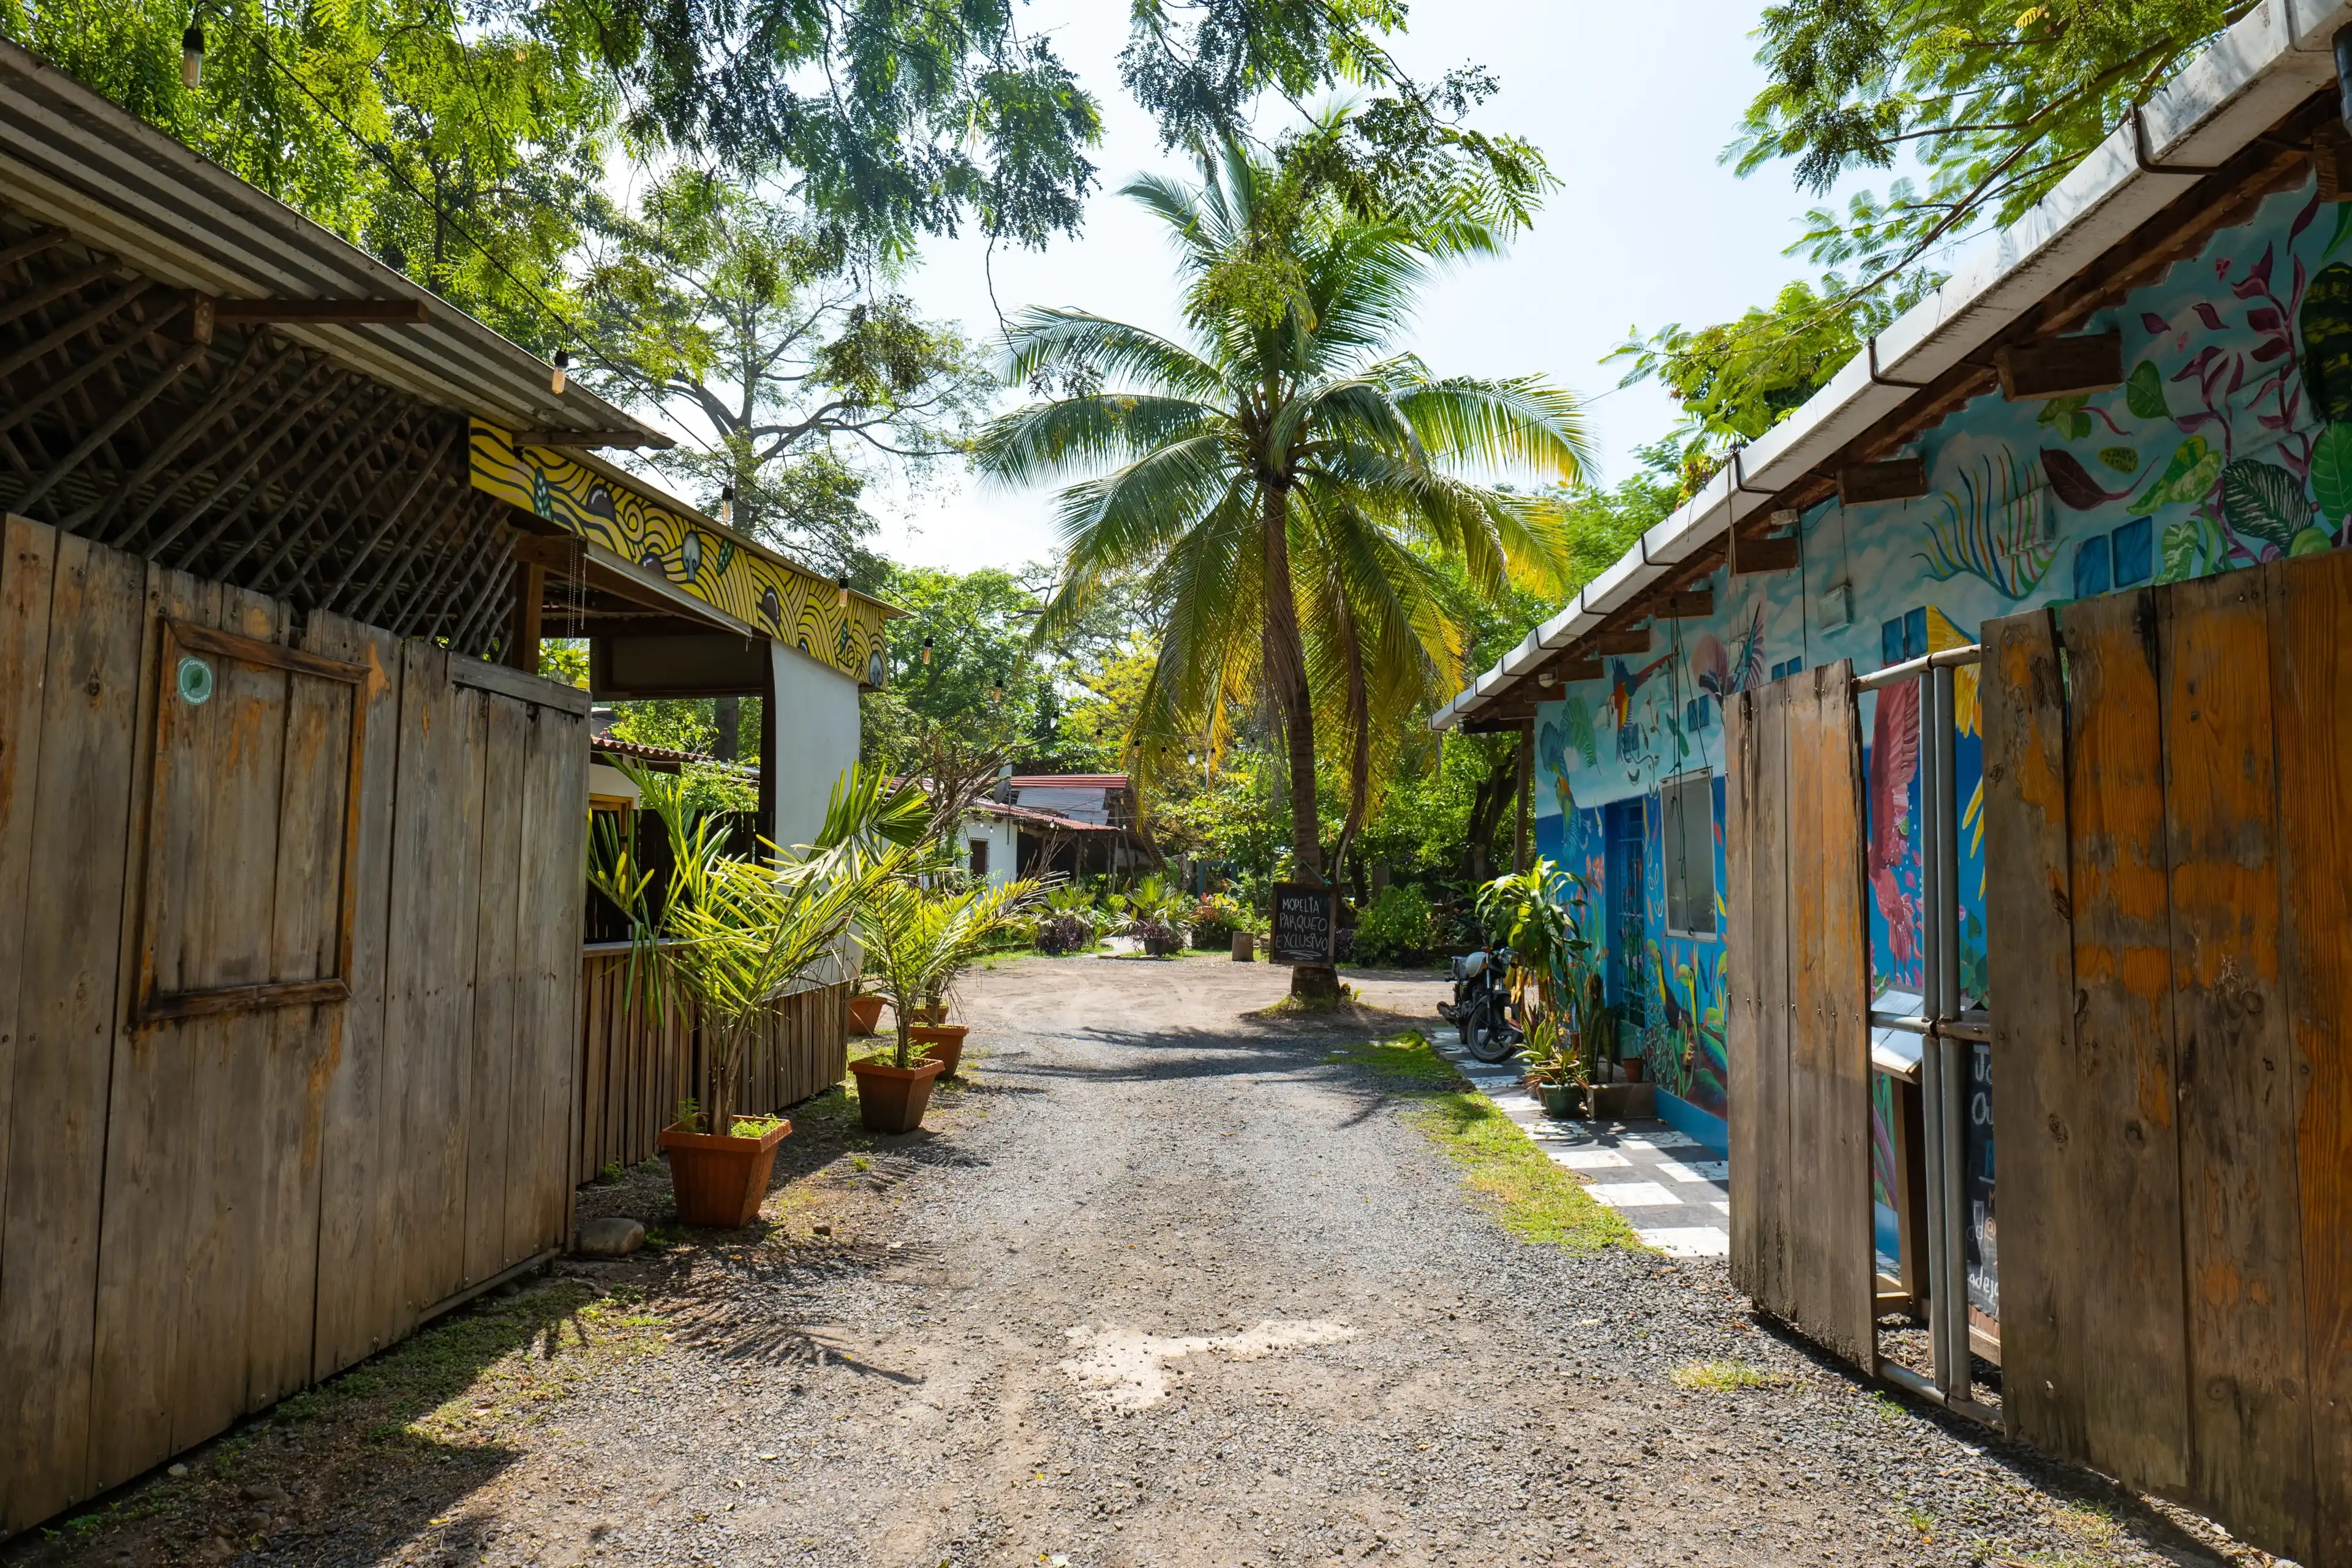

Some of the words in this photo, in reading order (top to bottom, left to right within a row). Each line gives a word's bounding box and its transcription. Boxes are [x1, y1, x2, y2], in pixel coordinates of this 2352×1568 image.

[183, 692, 209, 703] AMBIENTAL
[1280, 912, 1327, 932] PARQUEO
[1276, 933, 1328, 951] EXCLUSIVO
